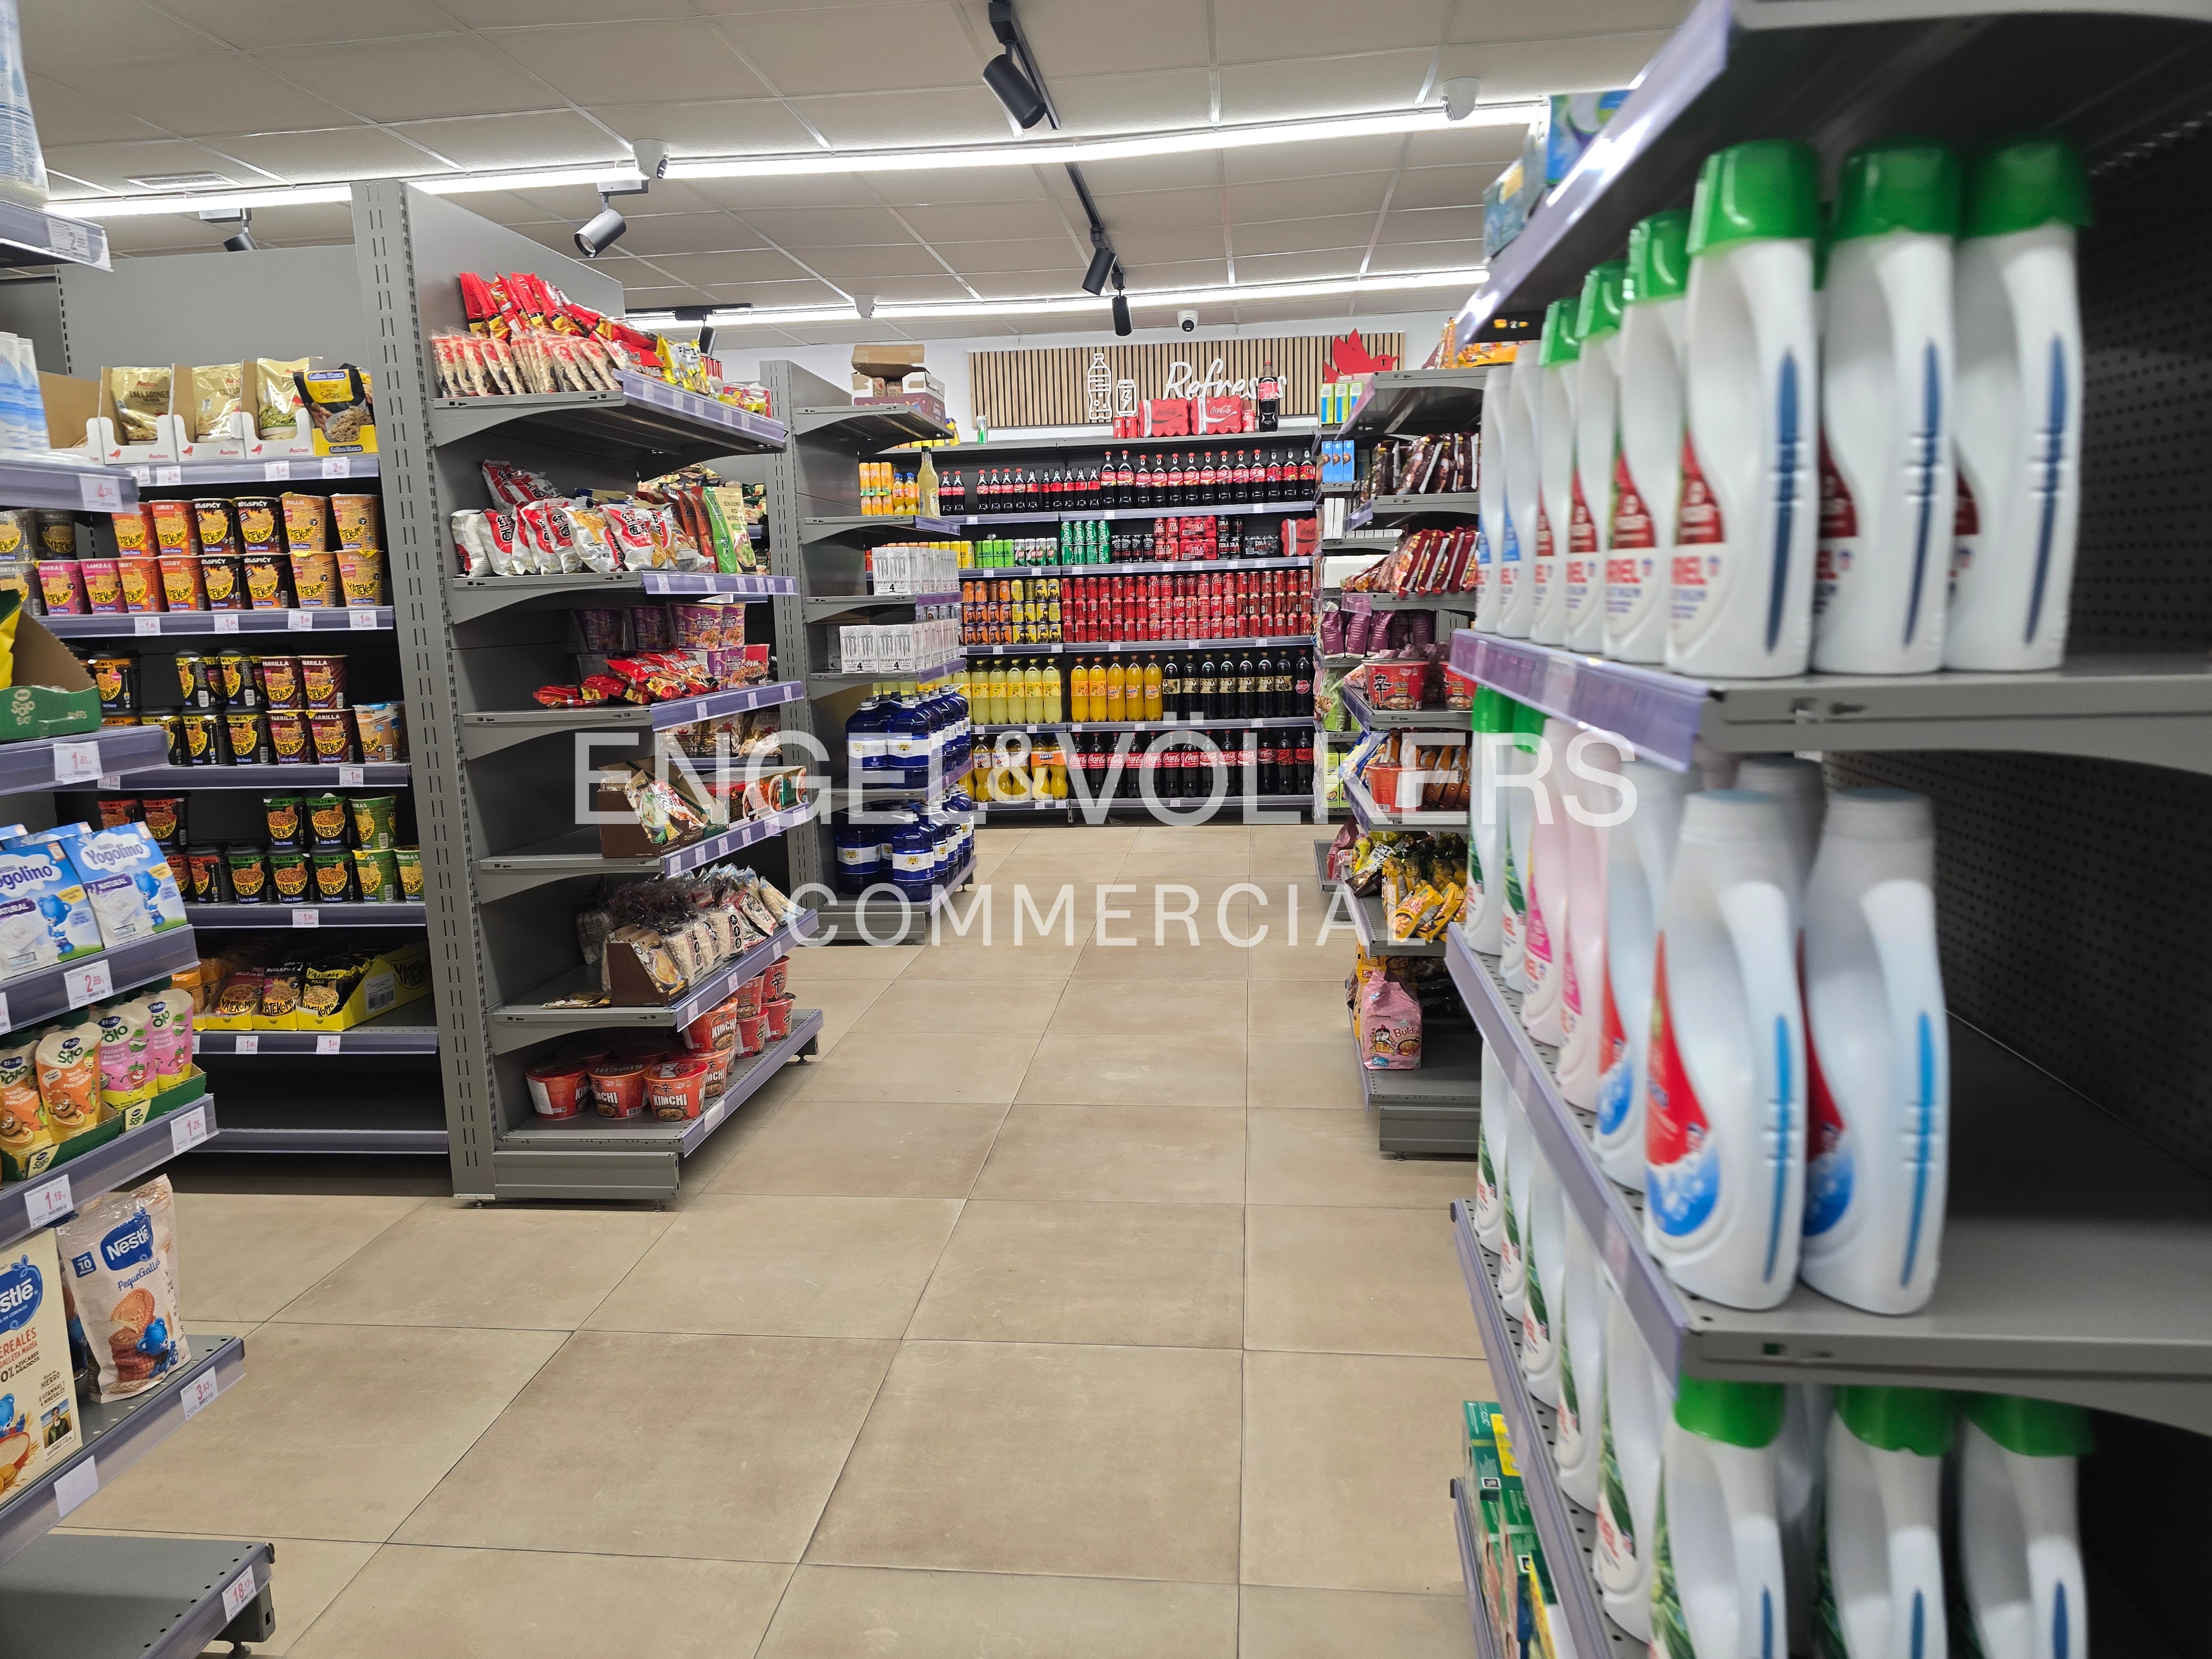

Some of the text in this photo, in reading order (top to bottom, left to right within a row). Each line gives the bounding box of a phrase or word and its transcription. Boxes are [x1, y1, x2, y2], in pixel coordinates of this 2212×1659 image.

[1162, 358, 1287, 401] Refress
[347, 581, 377, 596] YATEKOMO
[1374, 672, 1393, 703] 辛
[314, 822, 344, 837] YATEKOMO
[85, 843, 144, 865] Yogolino
[0, 865, 53, 890] ogolino
[276, 879, 306, 894] YATEKOMO
[319, 878, 346, 894] YATEKOMO
[0, 902, 30, 916] ATURAL
[393, 960, 430, 984] YATEKO
[771, 970, 785, 995] 辛
[222, 999, 255, 1013] YATEKOMO
[711, 1019, 737, 1039] KIMCHI
[705, 1068, 725, 1082] MCHI
[661, 1082, 672, 1097] 辛
[593, 1092, 619, 1104] MCHI
[653, 1093, 688, 1107] KIMCHI
[77, 1260, 92, 1271] 10
[0, 1277, 34, 1314] stlé
[0, 1327, 38, 1356] EREALES
[40, 1371, 61, 1390] HIERRO
